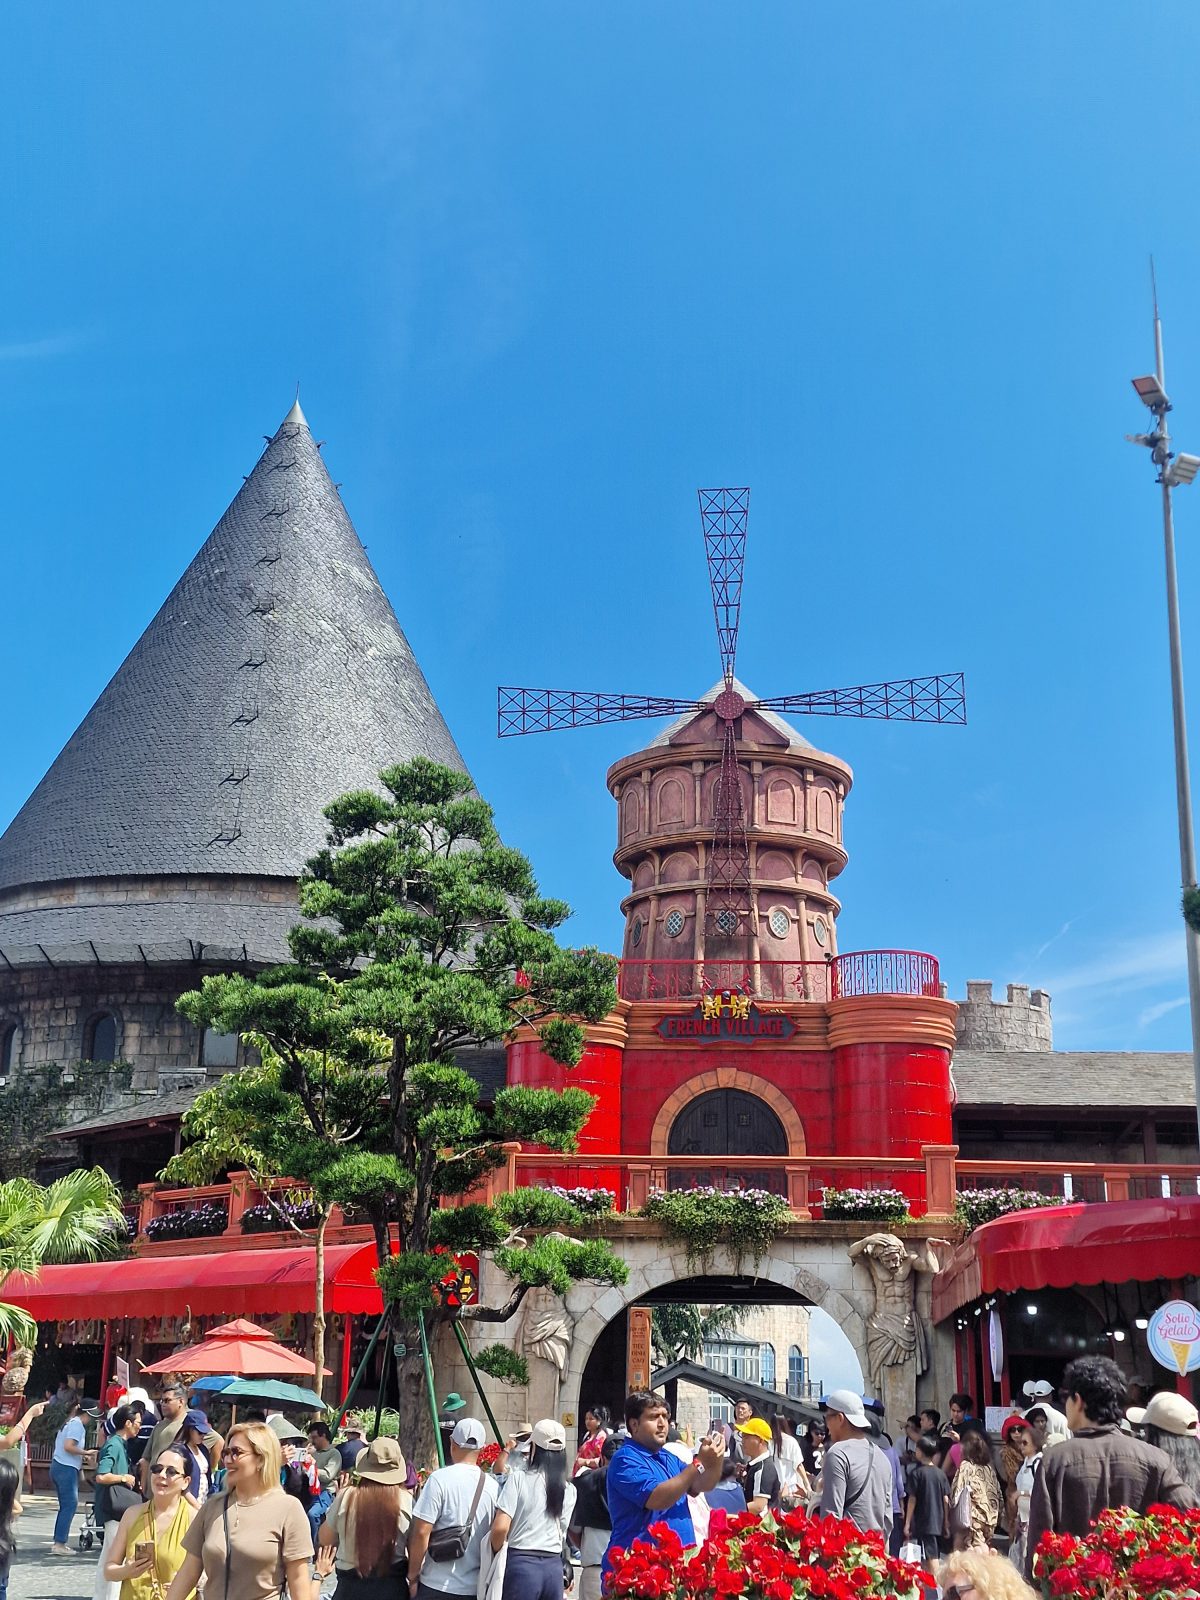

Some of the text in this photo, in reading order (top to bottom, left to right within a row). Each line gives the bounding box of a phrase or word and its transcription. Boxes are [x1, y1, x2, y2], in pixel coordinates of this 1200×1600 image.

[668, 1019, 783, 1035] FRENCH VILLAGE
[1158, 1324, 1194, 1339] Gelato
[812, 1450, 825, 1469] 2
